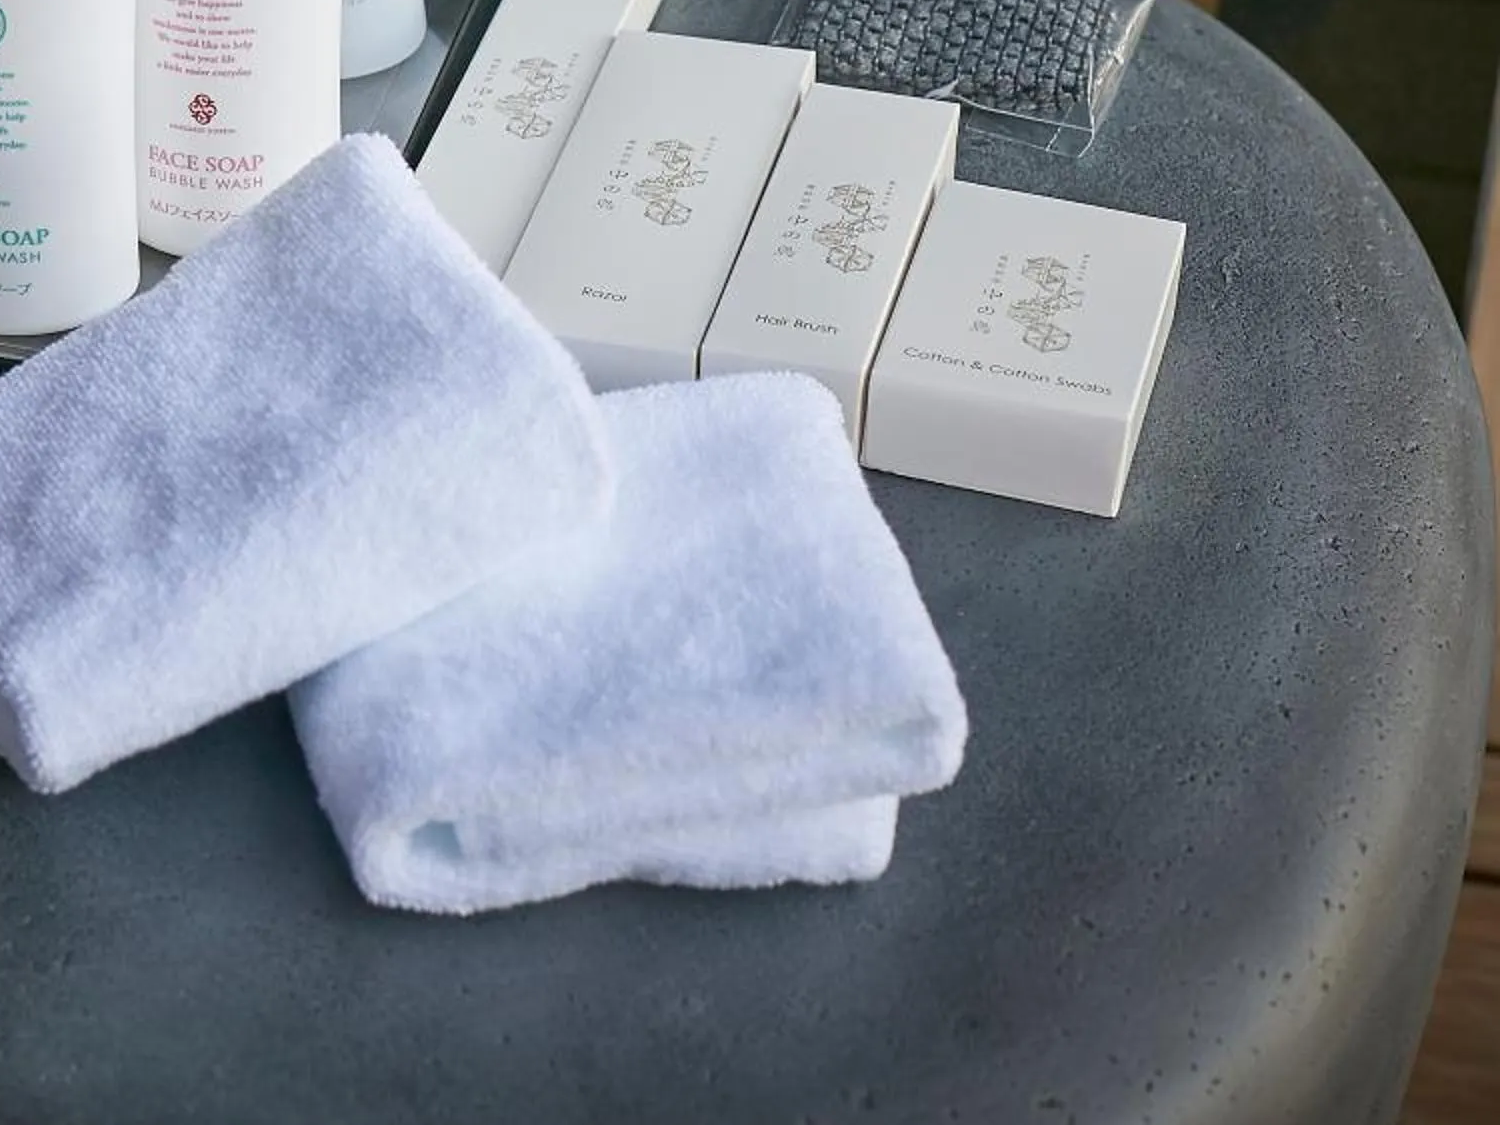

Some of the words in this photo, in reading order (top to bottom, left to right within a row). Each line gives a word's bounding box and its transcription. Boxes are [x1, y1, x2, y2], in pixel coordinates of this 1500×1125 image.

[148, 144, 200, 172] FACE
[204, 154, 265, 174] SOAP
[149, 166, 208, 190] BUBBLE
[215, 176, 263, 190] WASH
[581, 285, 628, 302] Razor
[755, 313, 787, 327] Hair
[793, 317, 838, 336] Brush
[902, 346, 967, 368] Cotton
[969, 359, 983, 371] &
[988, 363, 1050, 384] Cotton
[1051, 375, 1113, 396] Swabs
